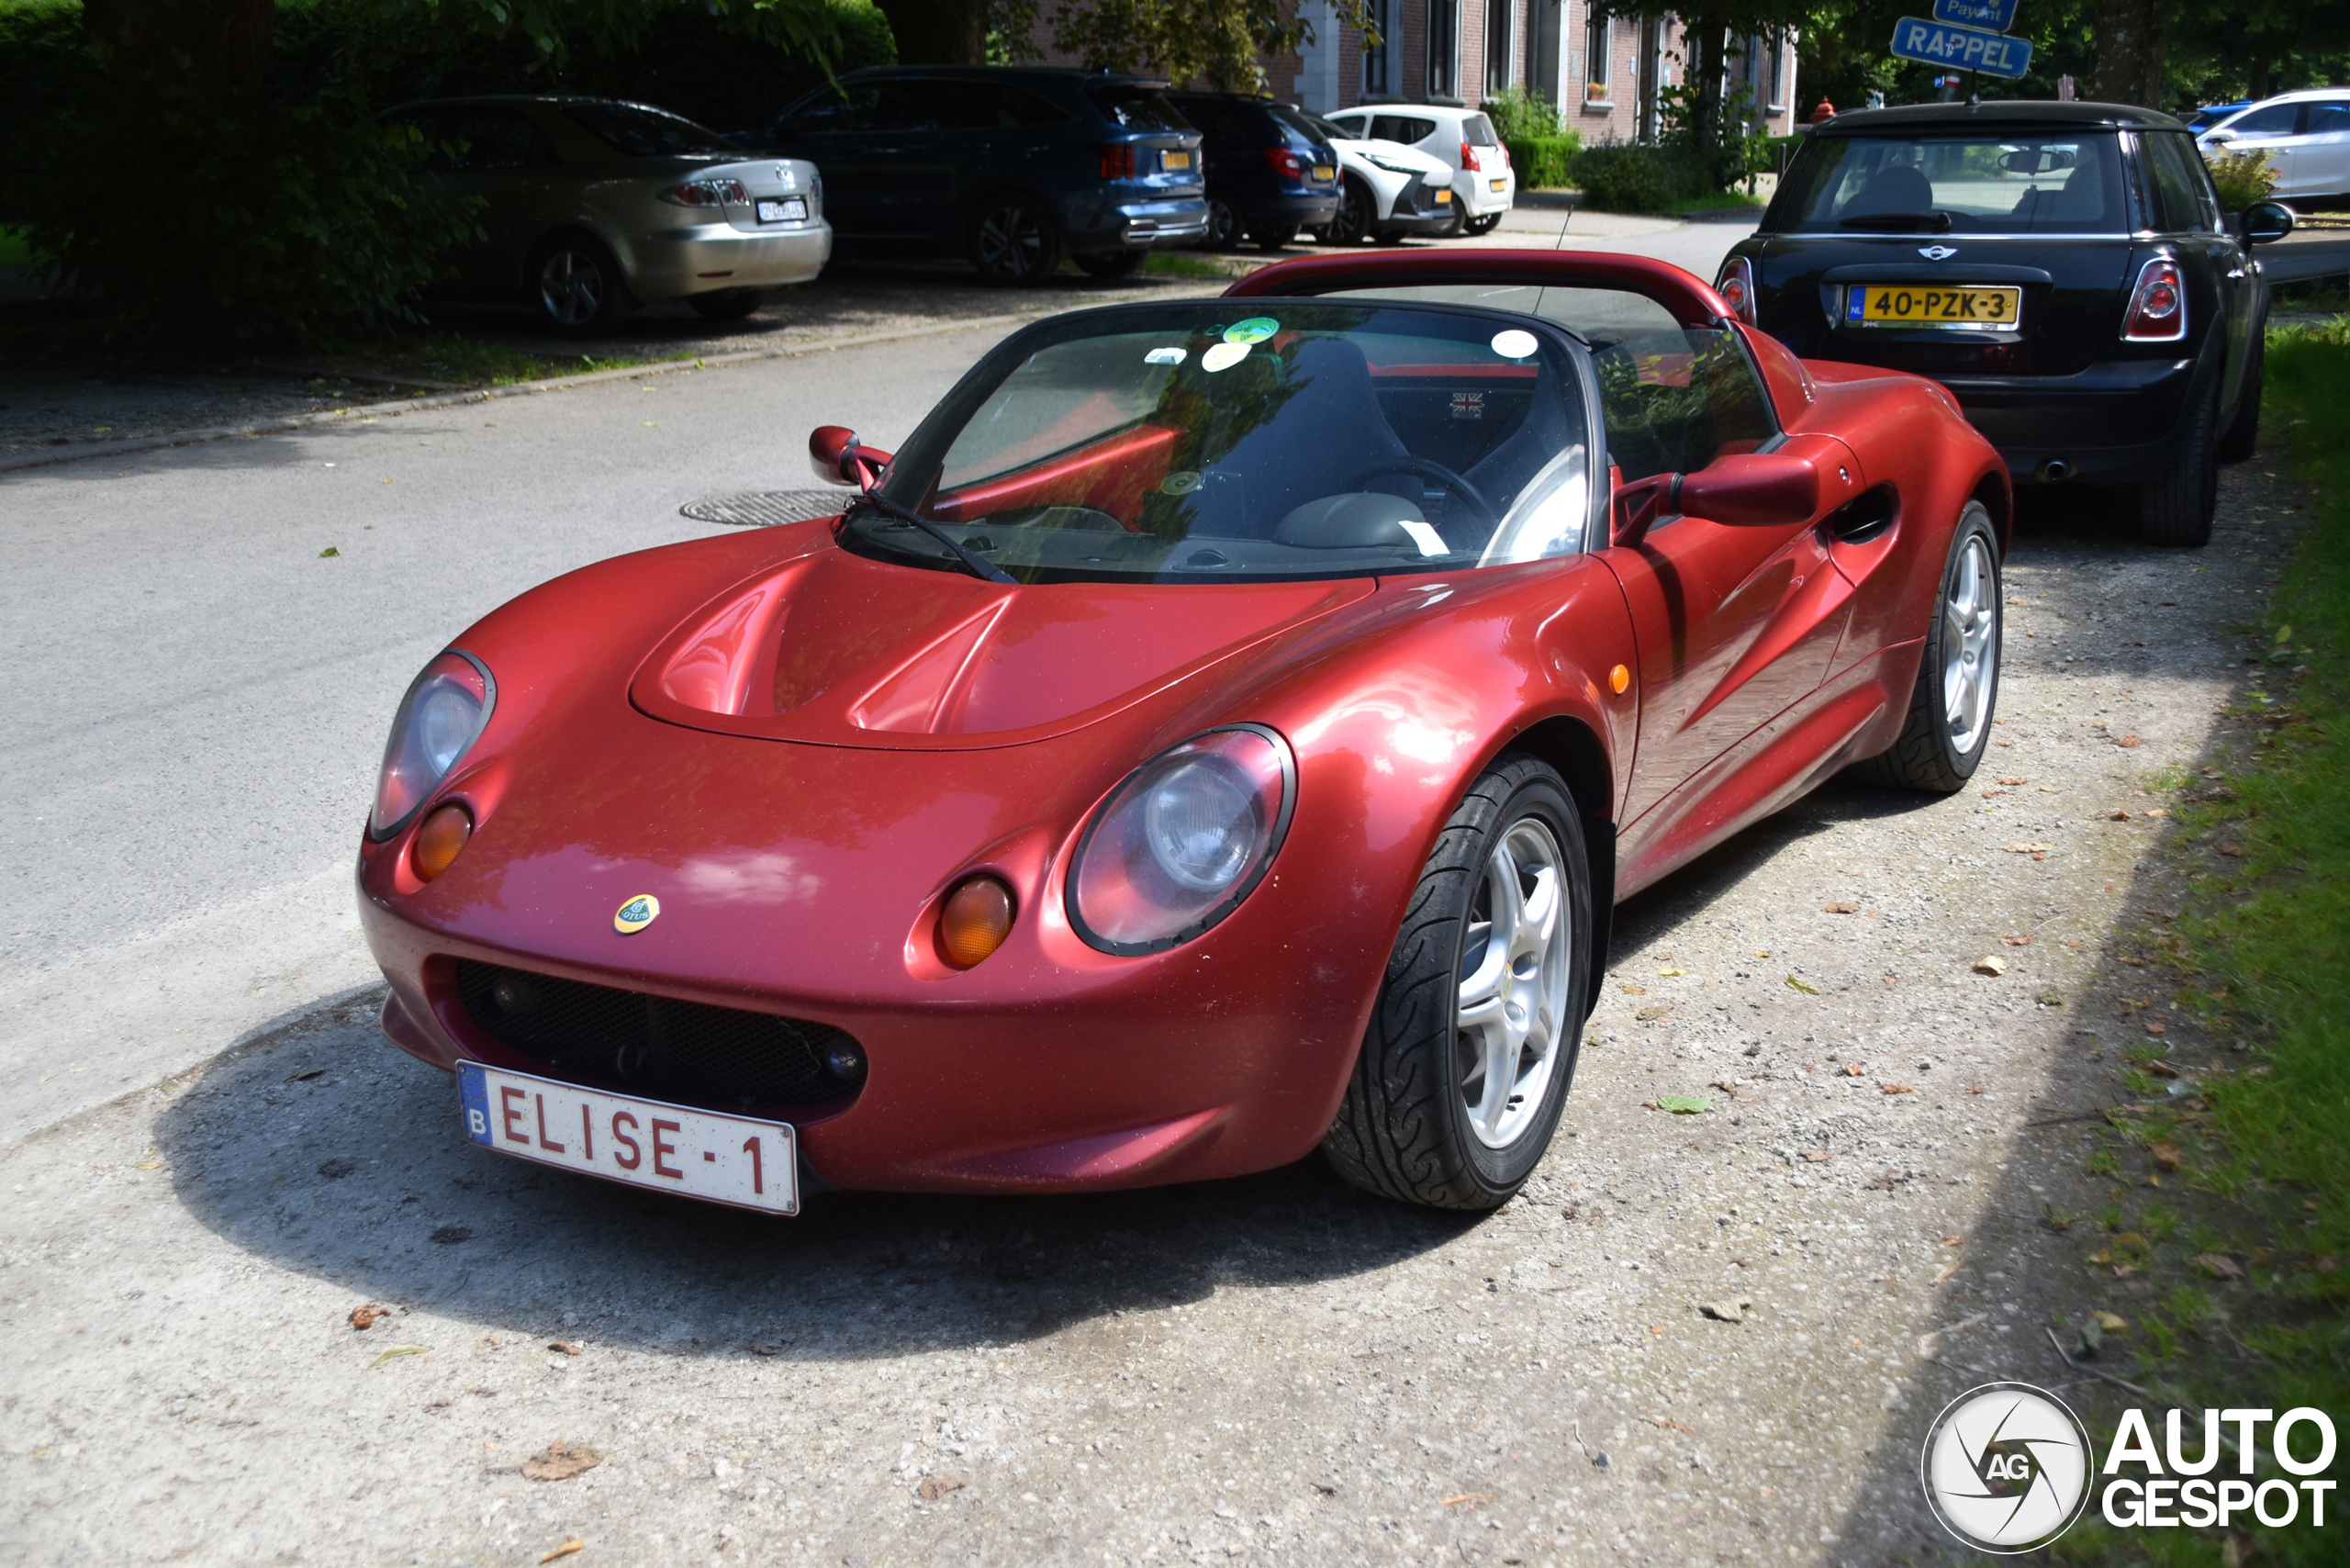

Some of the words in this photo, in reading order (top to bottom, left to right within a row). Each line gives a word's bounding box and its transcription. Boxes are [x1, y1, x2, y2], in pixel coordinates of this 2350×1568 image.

[1907, 25, 2013, 70] RAPPEL
[1851, 307, 1862, 315] NL
[1874, 291, 2005, 318] 40-PZK-3
[621, 908, 649, 920] LOTUS
[469, 1108, 487, 1135] B
